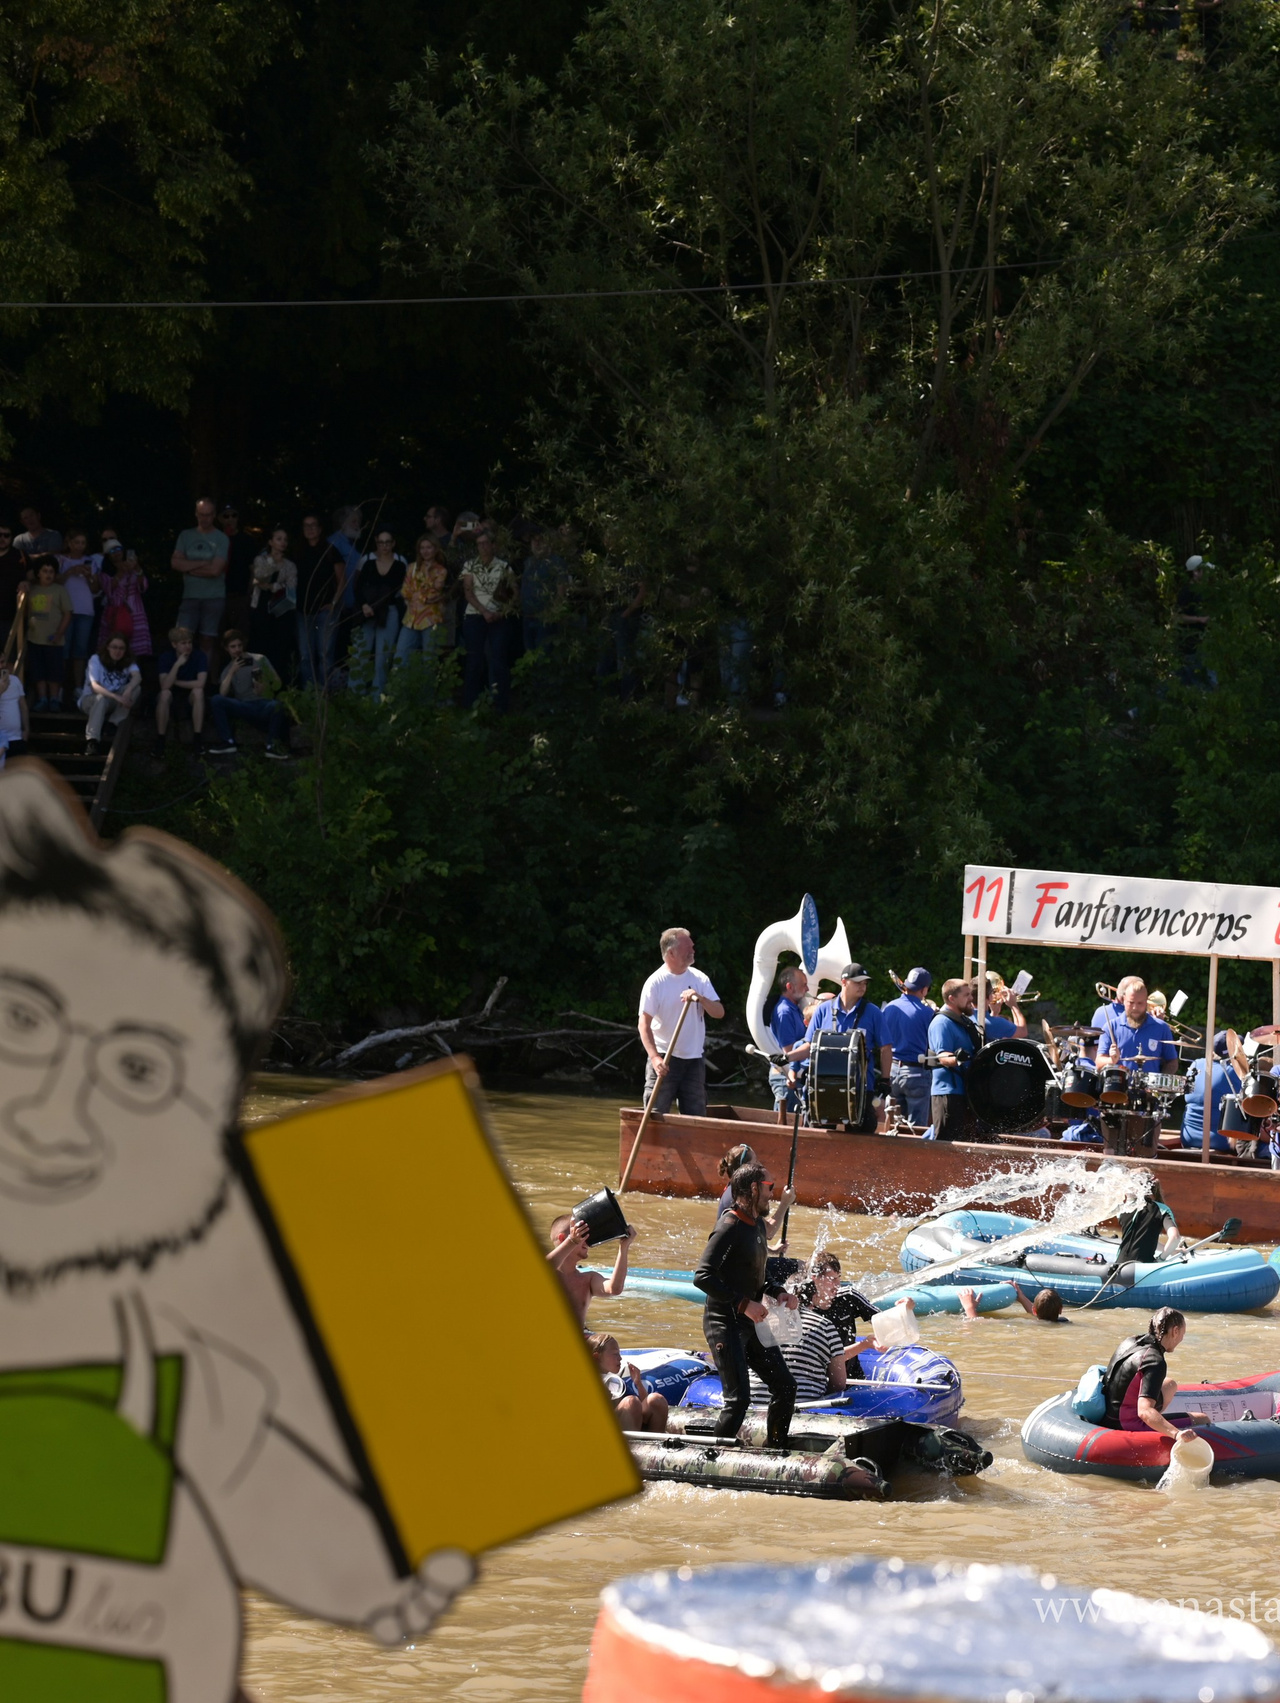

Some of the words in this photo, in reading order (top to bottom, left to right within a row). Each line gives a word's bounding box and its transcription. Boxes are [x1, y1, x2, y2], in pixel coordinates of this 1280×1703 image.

[965, 875, 1003, 922] 11
[1031, 882, 1252, 949] Fanfarencorps
[0, 1562, 75, 1624] U
